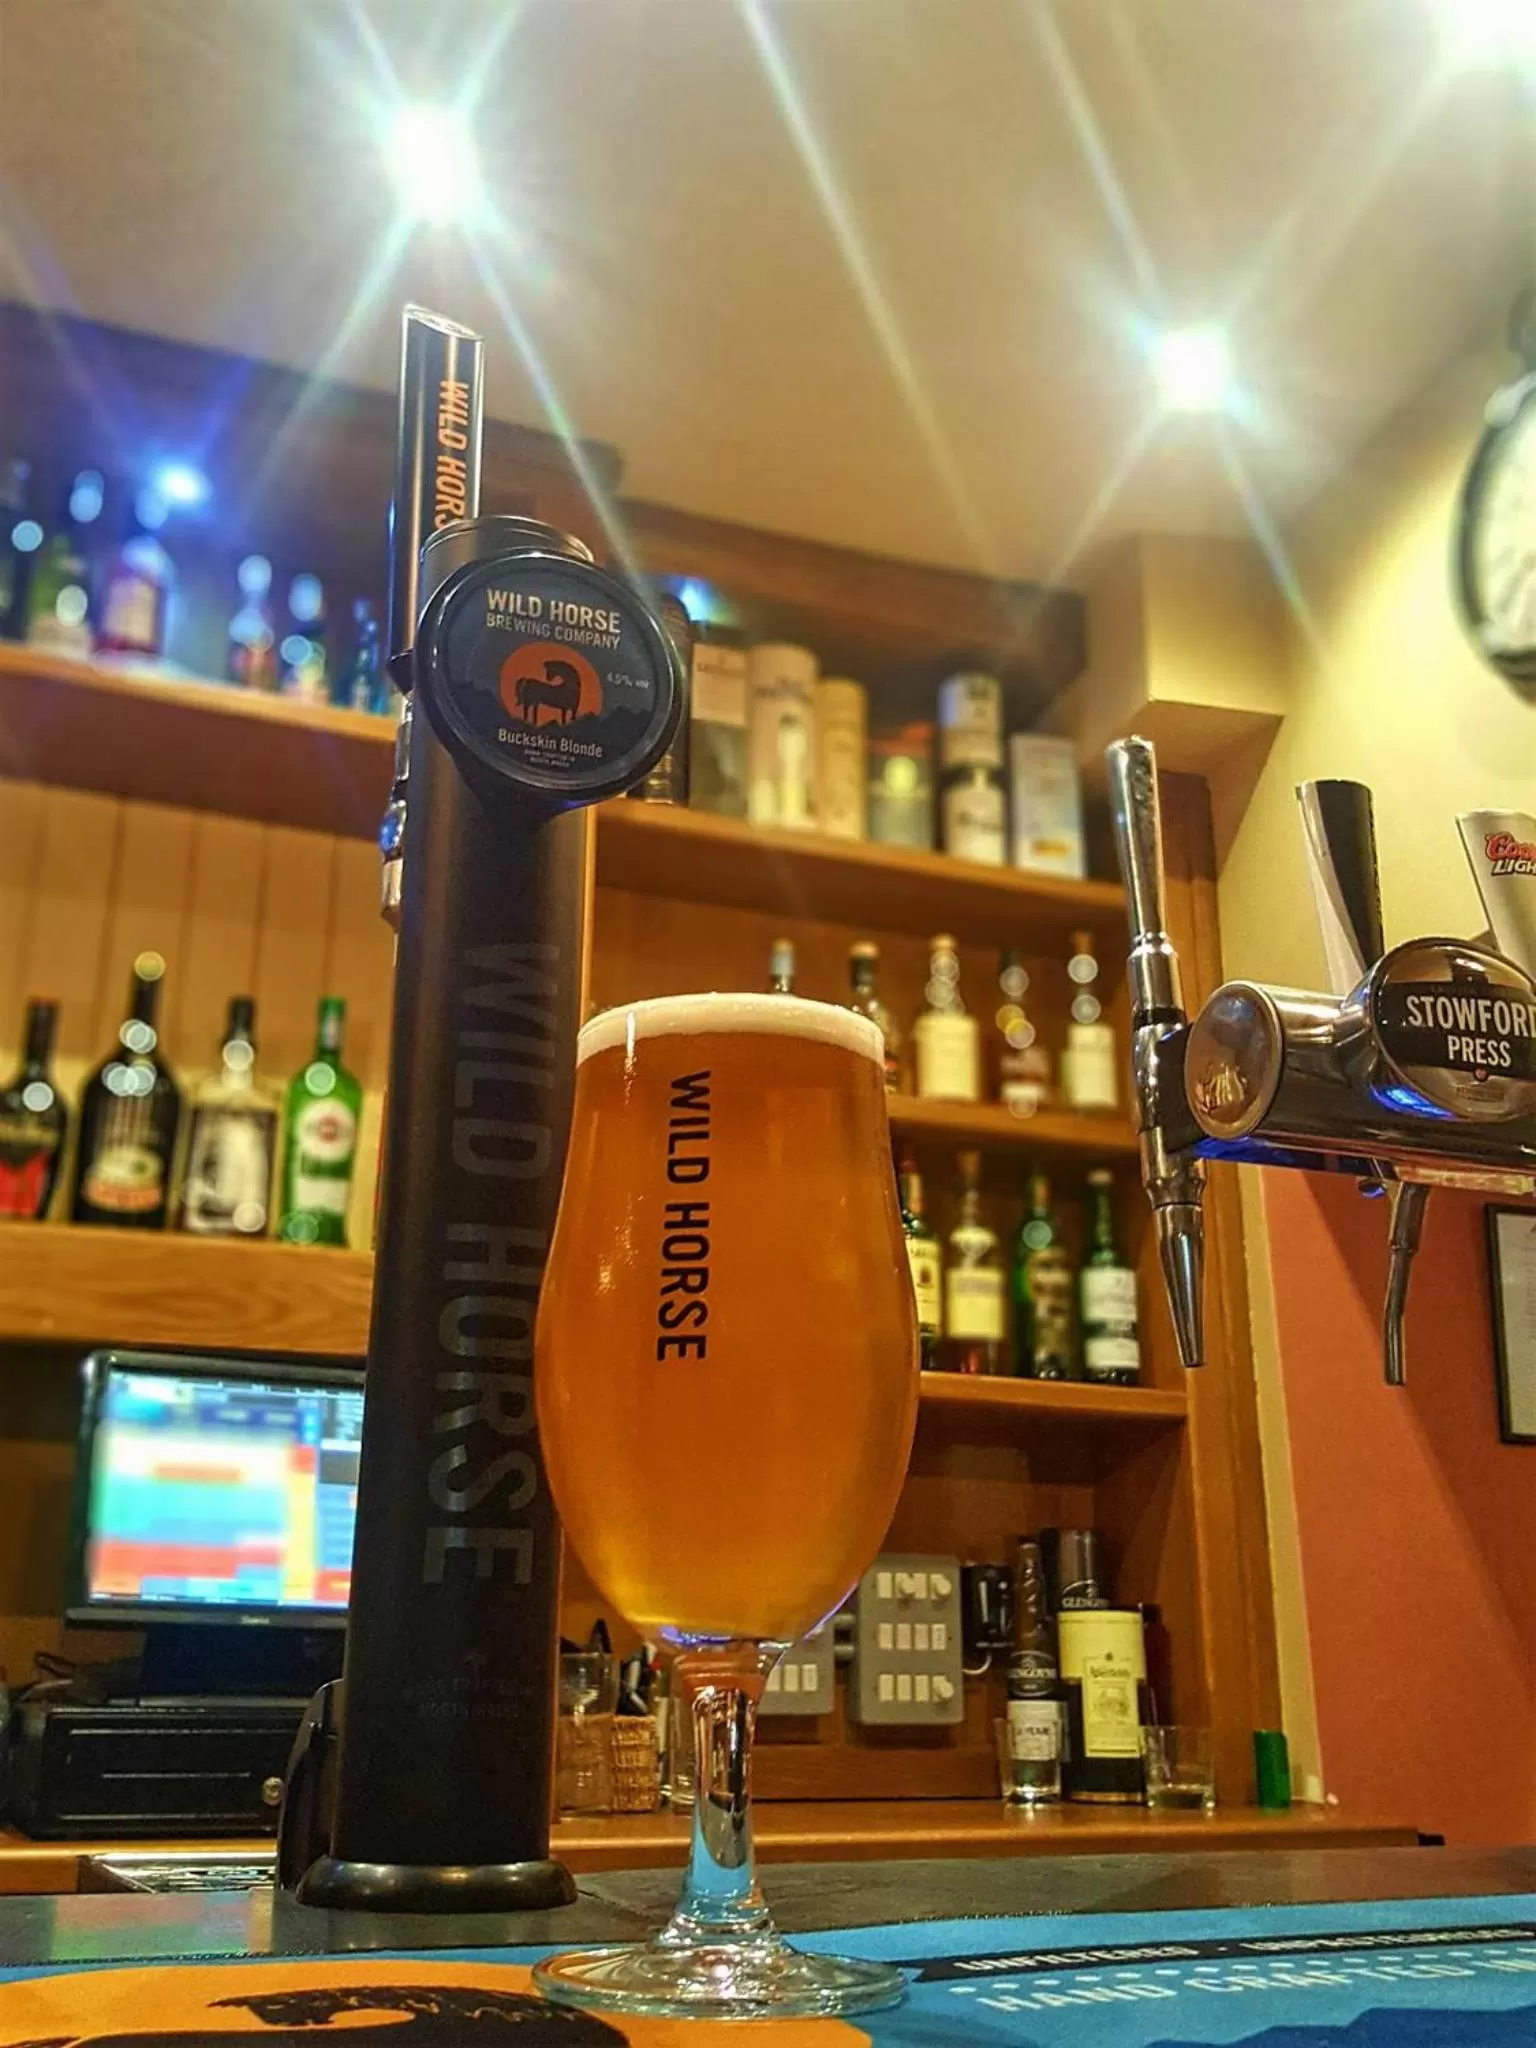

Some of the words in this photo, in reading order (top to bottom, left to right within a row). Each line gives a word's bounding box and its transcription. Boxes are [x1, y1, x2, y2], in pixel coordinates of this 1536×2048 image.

[438, 379, 468, 450] WILD
[486, 612, 551, 638] BREWING
[554, 626, 621, 650] COMPANY
[487, 587, 543, 618] WILD
[550, 599, 622, 634] HORSE
[498, 727, 557, 749] Buckskin
[560, 737, 603, 758] Blonde
[452, 942, 560, 1179] WILD
[1447, 1034, 1511, 1068] PRESS
[667, 1070, 711, 1184] WILD
[657, 1202, 710, 1361] HORSE
[423, 1222, 549, 1585] HORSE
[976, 1983, 1179, 2012] HAND
[1183, 1963, 1476, 1993] CRAFTED
